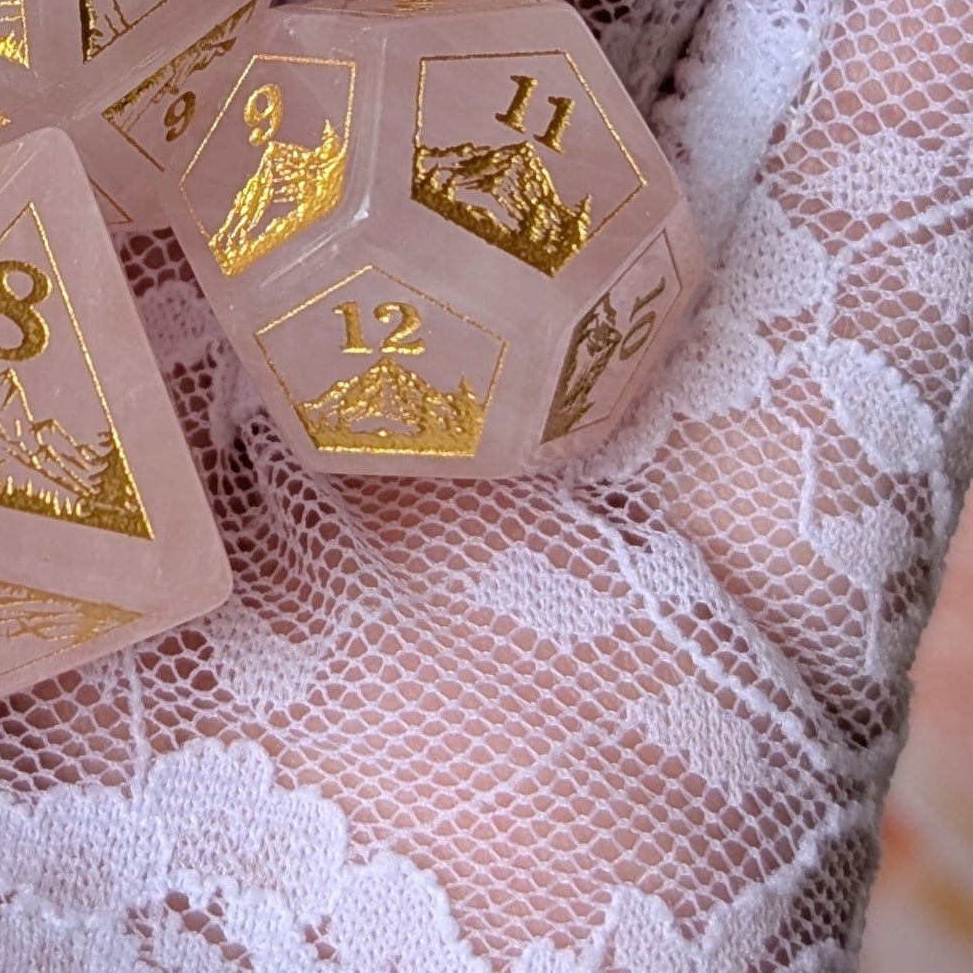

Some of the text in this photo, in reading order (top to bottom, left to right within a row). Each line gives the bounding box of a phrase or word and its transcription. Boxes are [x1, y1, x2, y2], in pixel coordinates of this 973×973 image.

[243, 83, 284, 147] 9
[495, 74, 575, 153] 11
[332, 302, 426, 355] 12
[619, 277, 666, 363] 10
